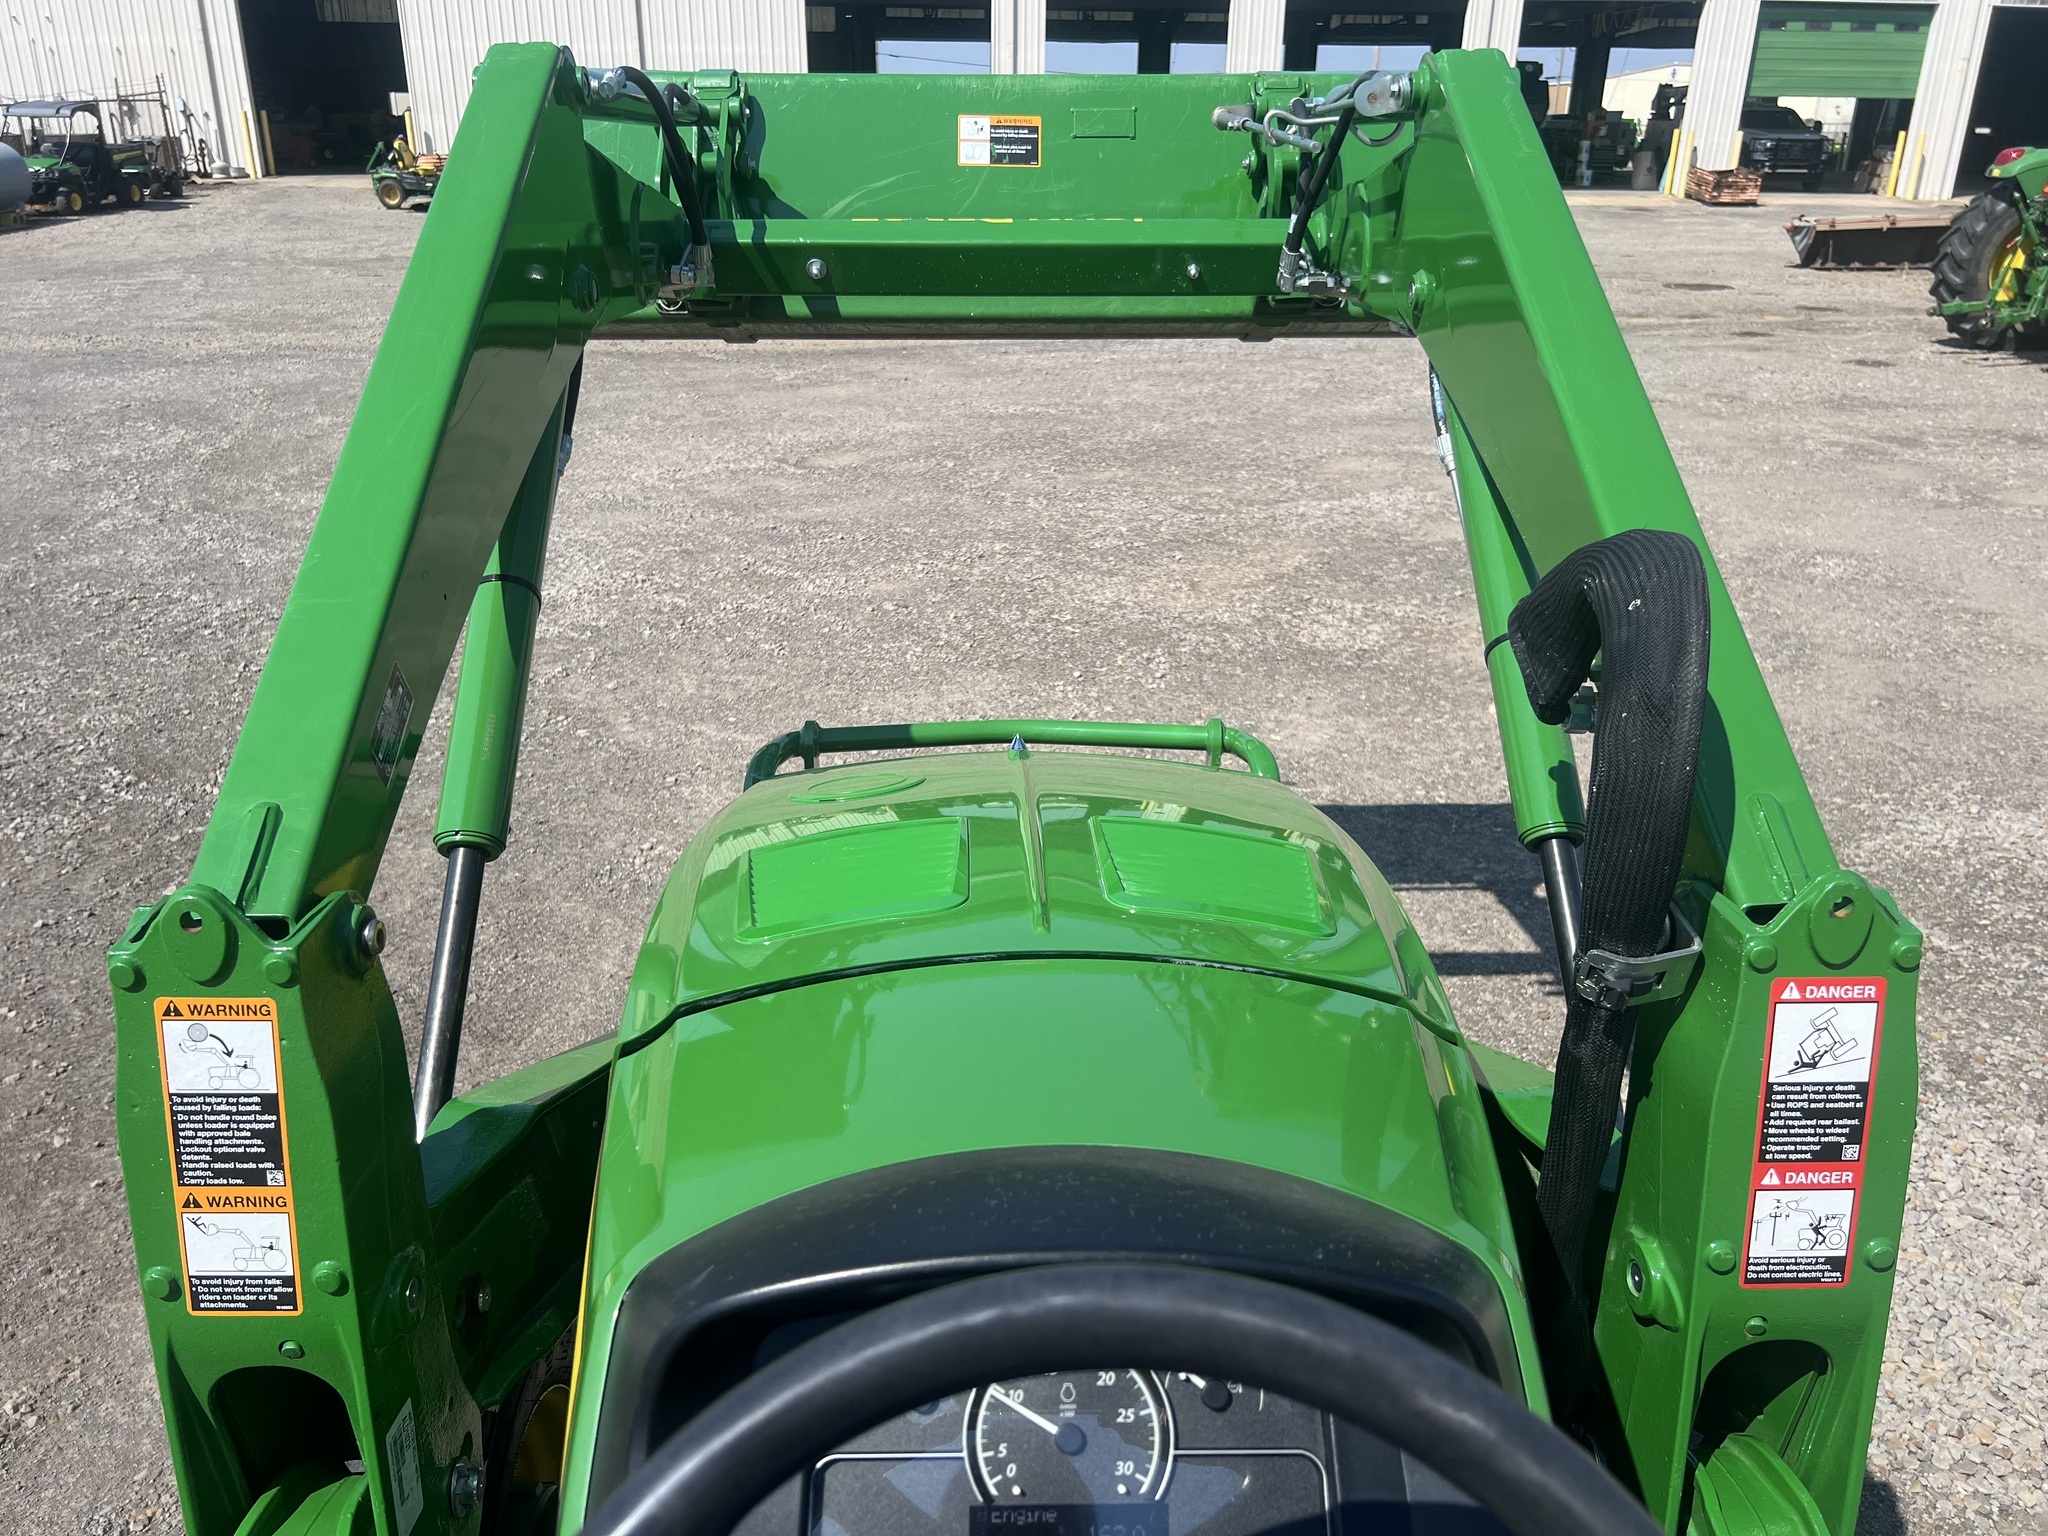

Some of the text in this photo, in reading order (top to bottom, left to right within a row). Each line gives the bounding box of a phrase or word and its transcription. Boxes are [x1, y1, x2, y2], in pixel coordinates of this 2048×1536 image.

[1805, 985, 1876, 999] DANGER
[187, 1004, 271, 1016] WARNING
[205, 1096, 226, 1104] injury
[239, 1122, 275, 1130] equipped
[197, 1130, 233, 1138] approved
[180, 1138, 212, 1146] handling
[1785, 1172, 1853, 1184] DANGER
[206, 1196, 287, 1208] WARNING
[223, 1278, 244, 1286] injury
[1096, 1371, 1116, 1386] 20
[1008, 1388, 1024, 1404] 10
[1116, 1408, 1135, 1423] 25
[997, 1443, 1008, 1458] 5
[1006, 1463, 1017, 1478] 0
[1114, 1460, 1134, 1476] 30
[991, 1510, 1057, 1525] Engine
